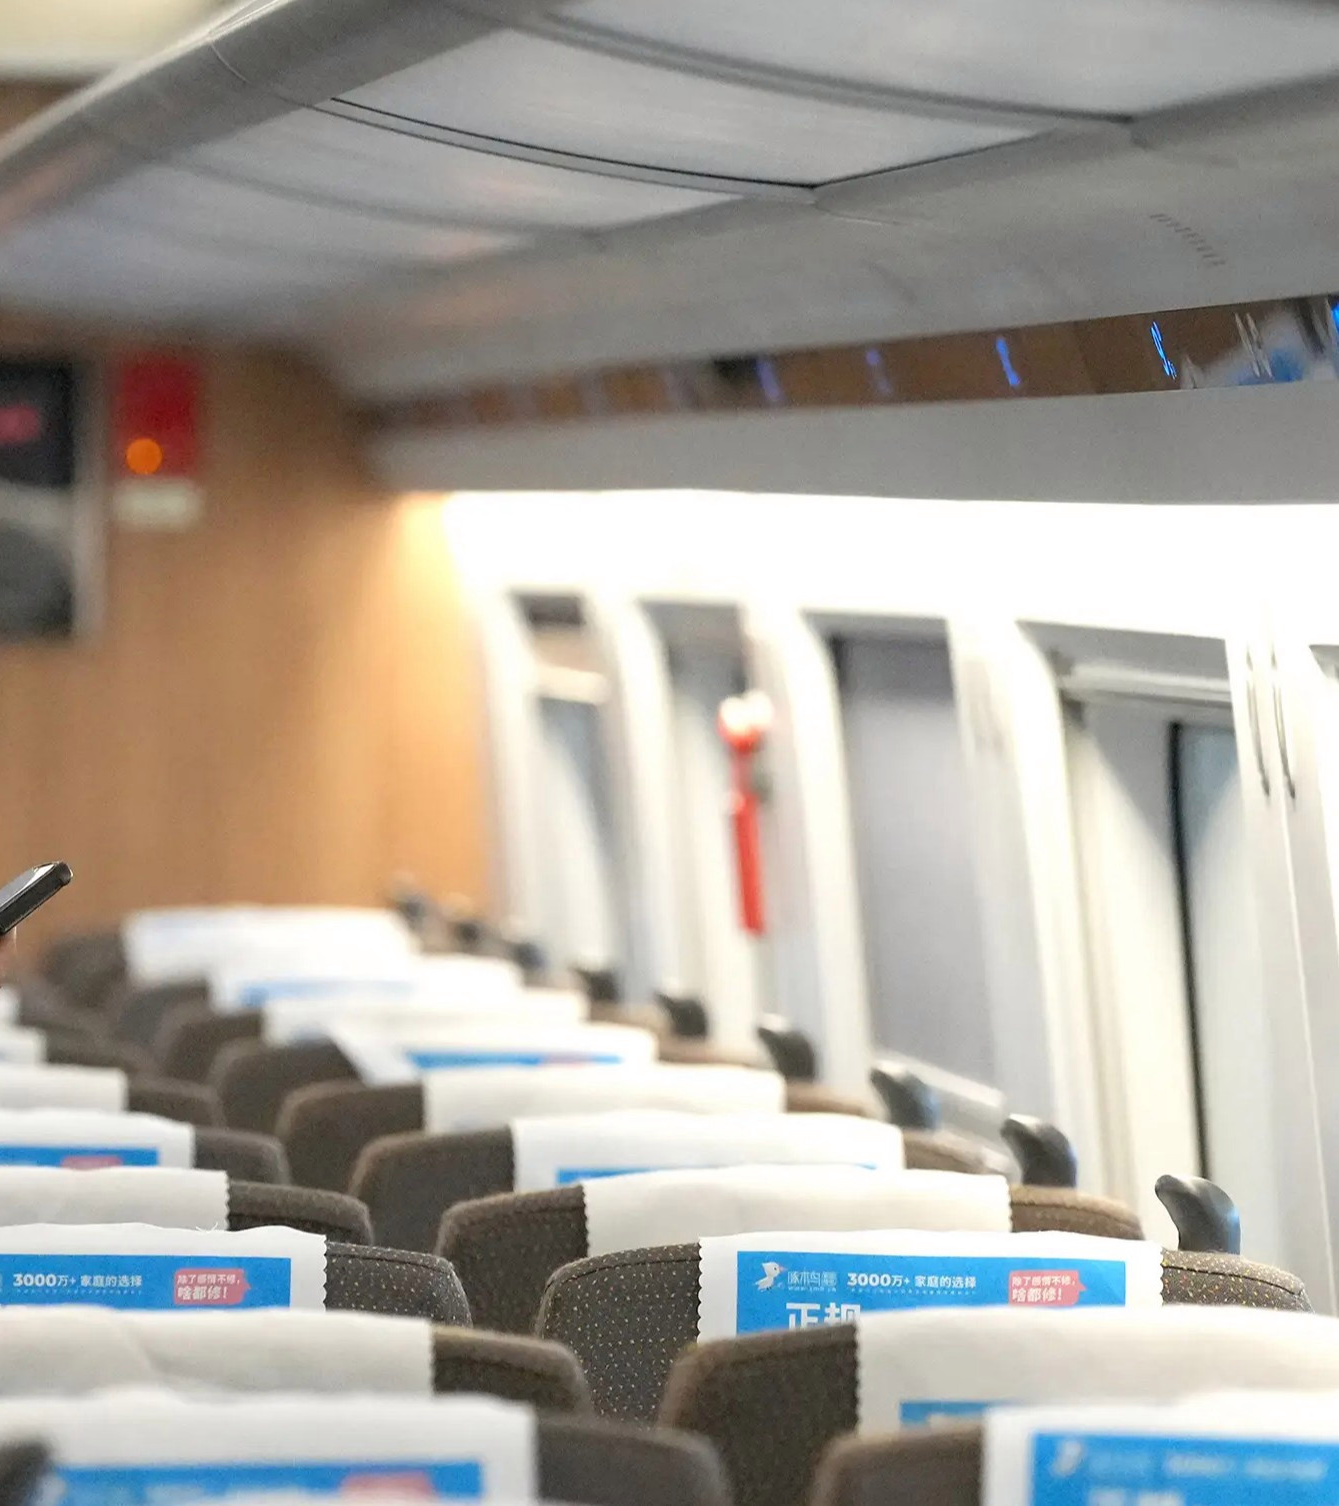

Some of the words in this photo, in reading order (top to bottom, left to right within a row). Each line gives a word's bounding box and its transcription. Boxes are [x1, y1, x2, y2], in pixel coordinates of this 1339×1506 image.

[13, 1273, 76, 1288] 3000万+
[80, 1274, 143, 1288] 家庭的选择
[847, 1272, 910, 1287] 3000万+
[914, 1274, 977, 1289] 家庭的选择
[177, 1286, 228, 1301] 啥都修！
[1012, 1287, 1062, 1303] 啥都修！
